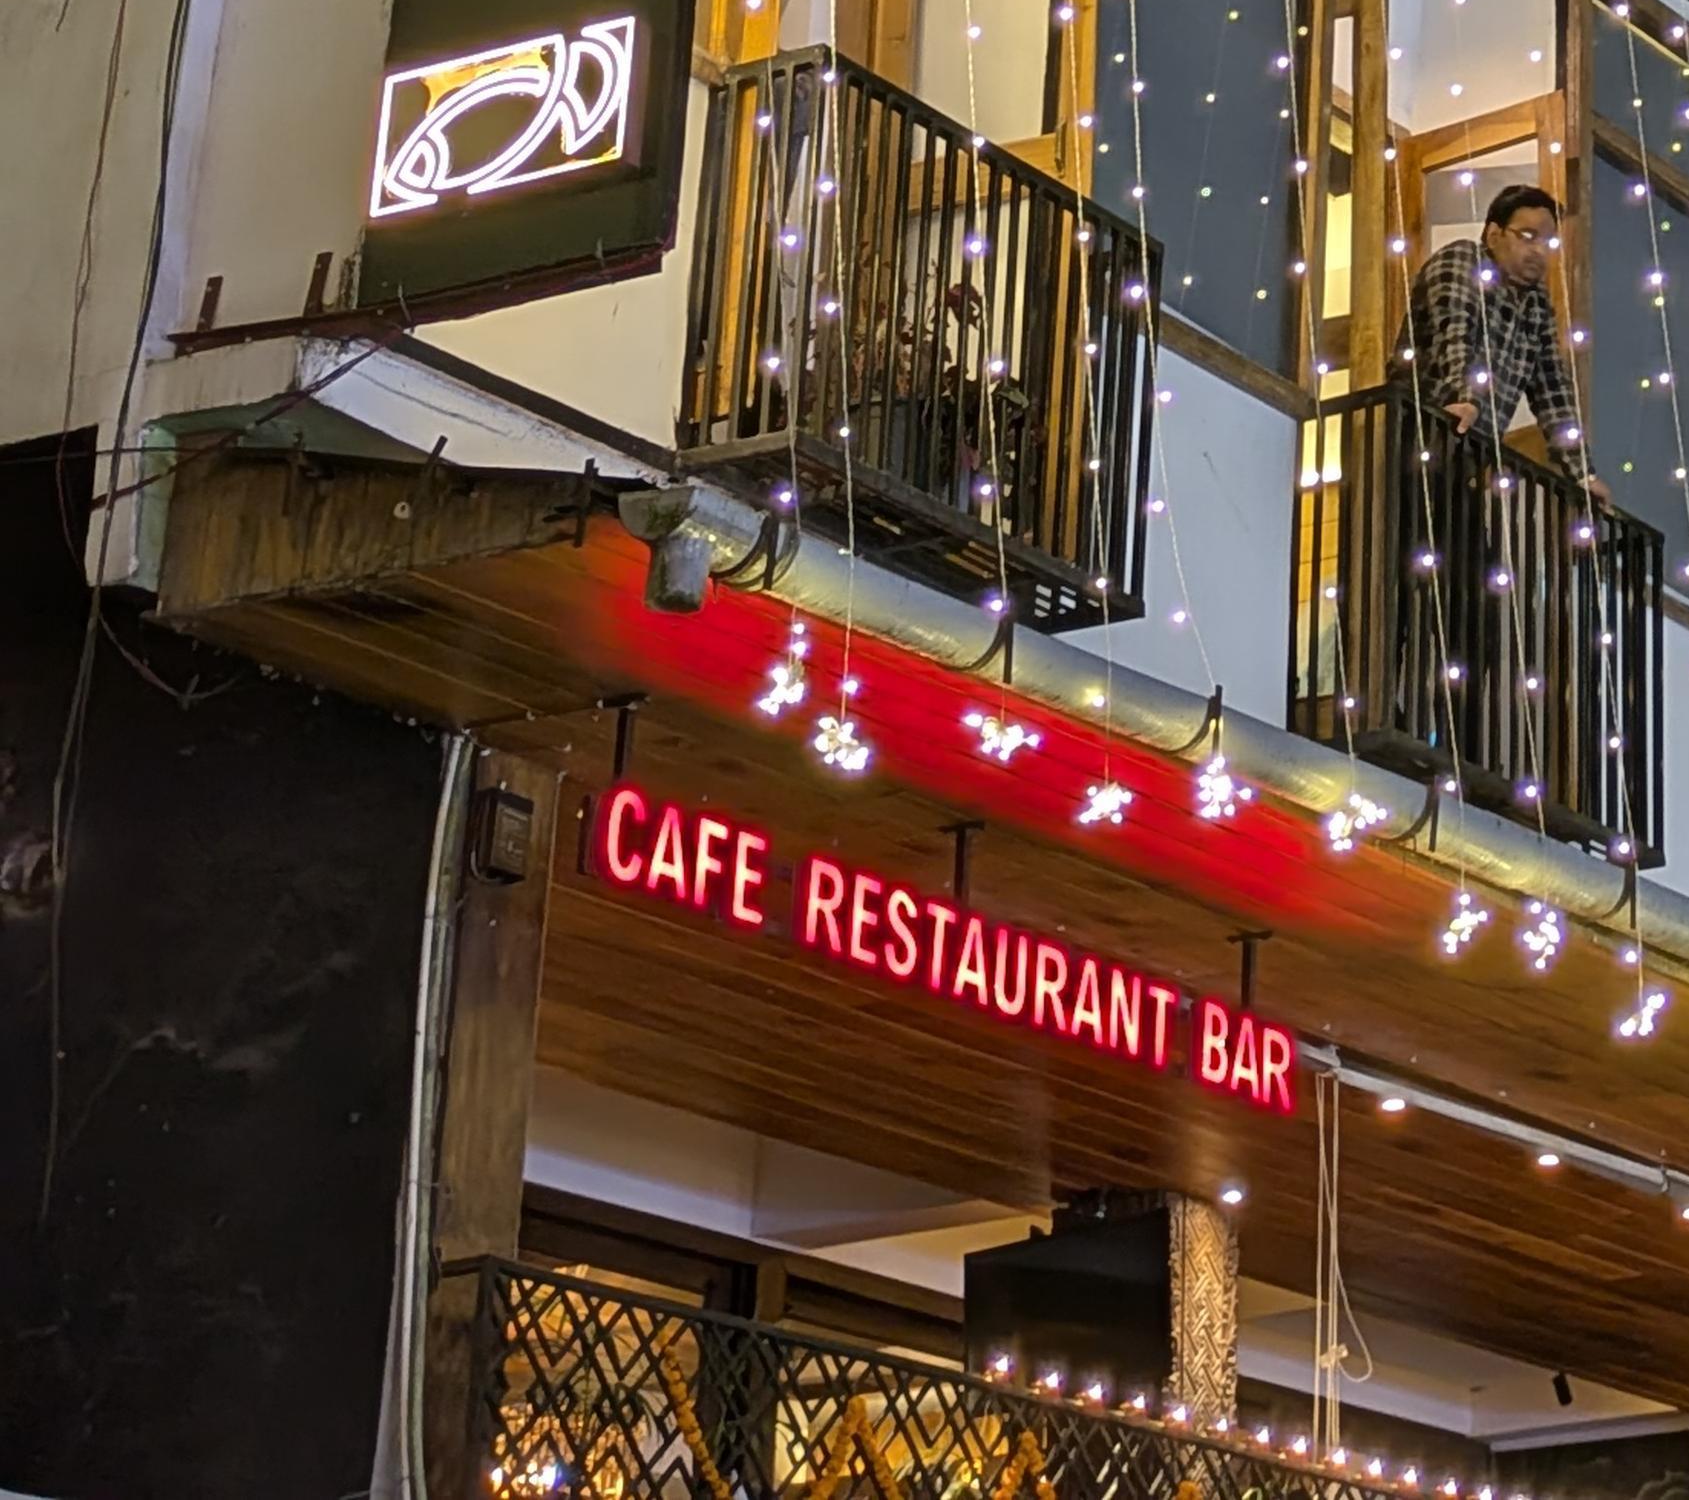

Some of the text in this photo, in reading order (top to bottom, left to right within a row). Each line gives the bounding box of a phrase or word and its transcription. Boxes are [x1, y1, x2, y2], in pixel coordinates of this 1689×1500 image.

[606, 789, 767, 925] CAFE
[805, 858, 1176, 1068] RESTAURANT
[1201, 1001, 1294, 1112] BAR
